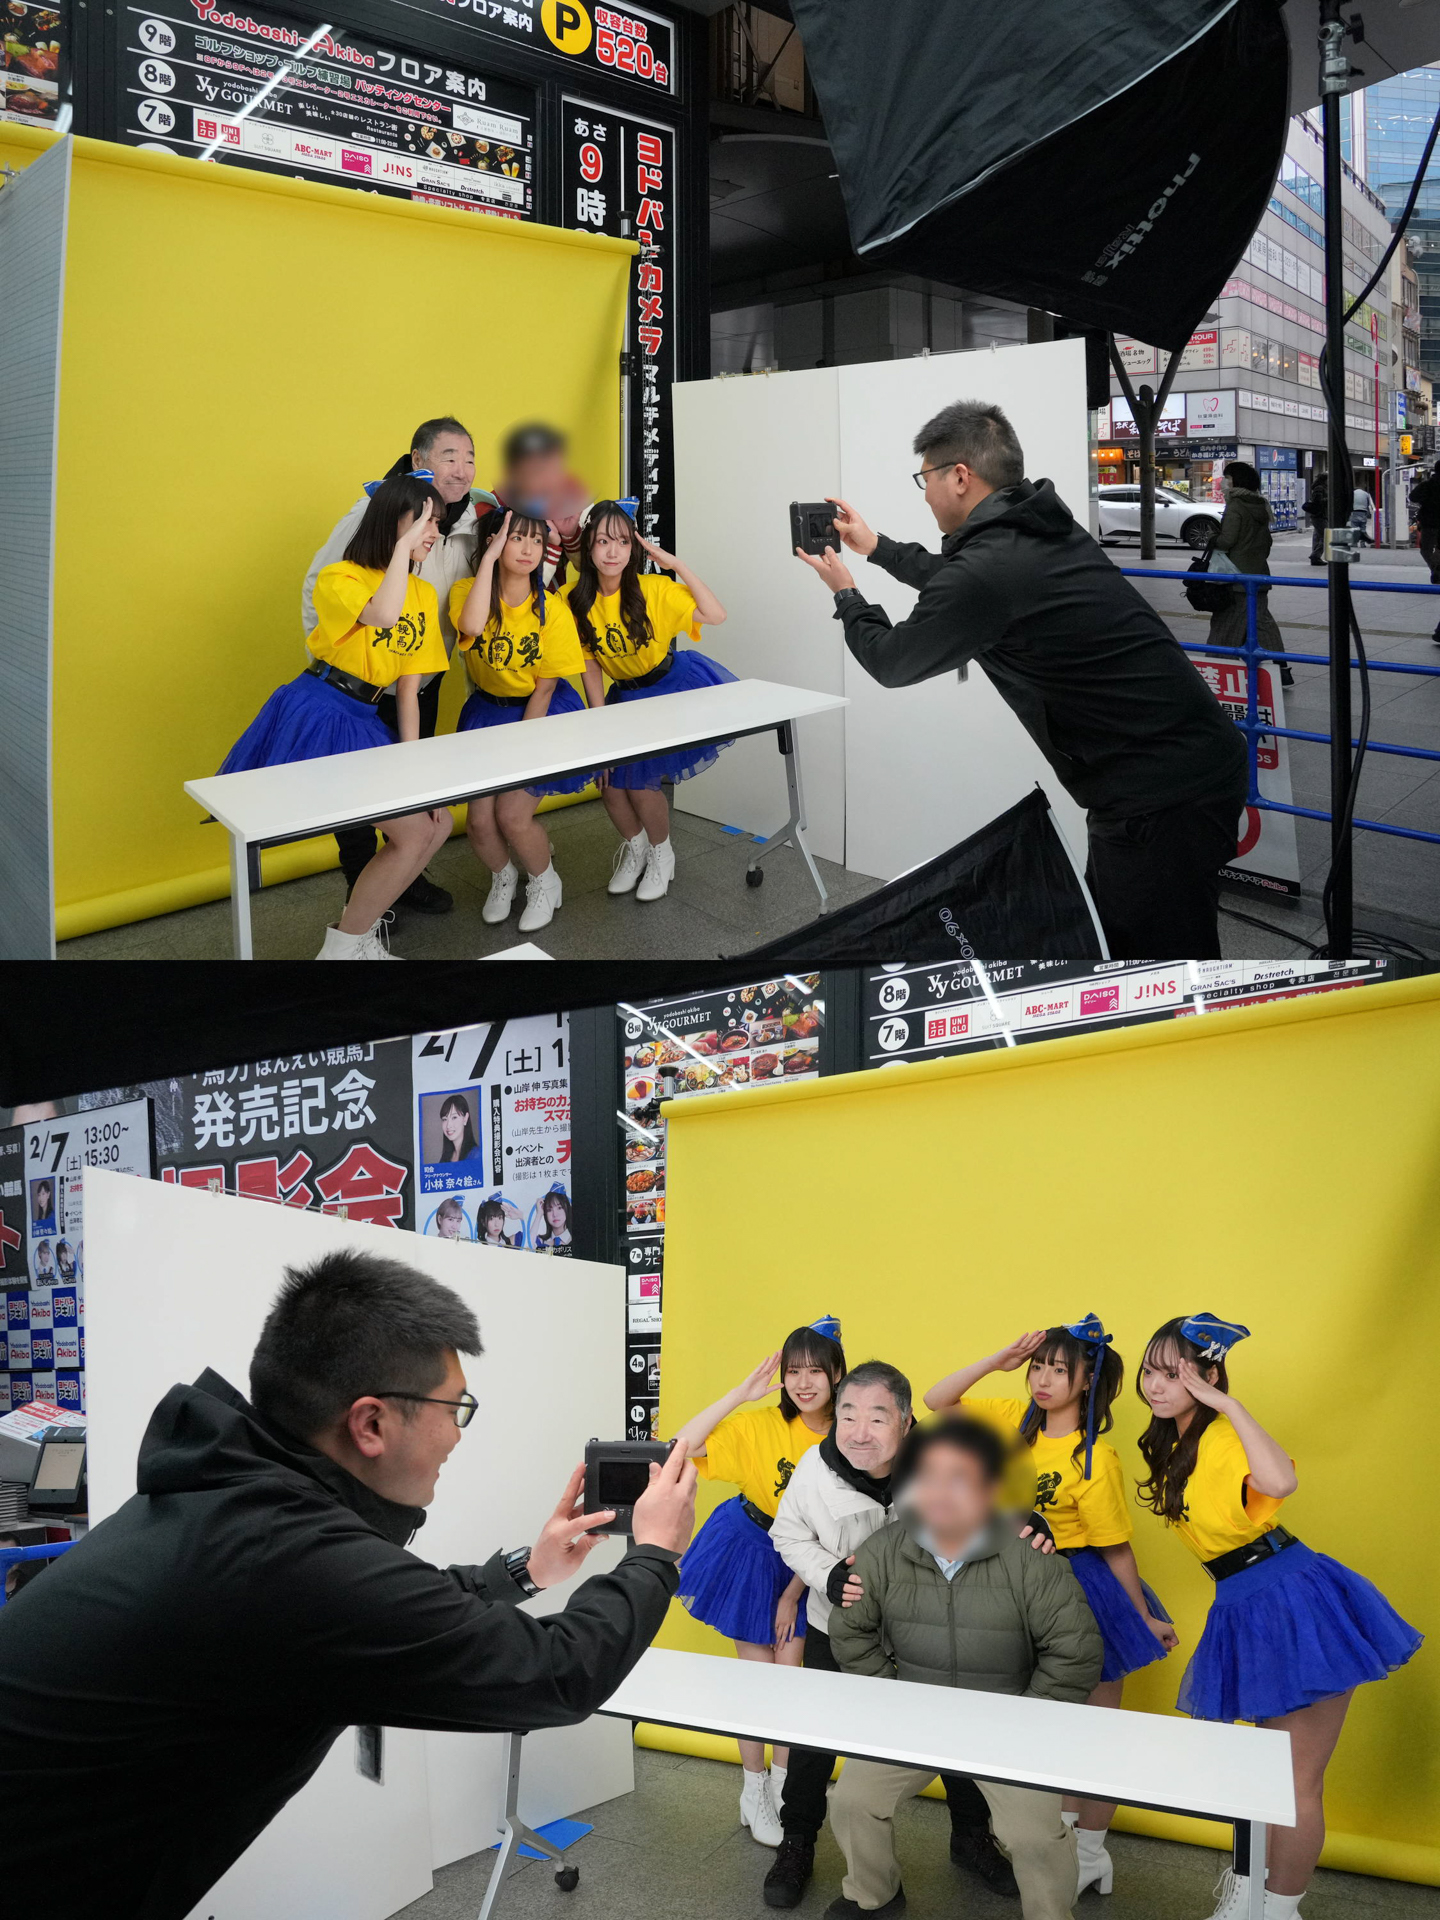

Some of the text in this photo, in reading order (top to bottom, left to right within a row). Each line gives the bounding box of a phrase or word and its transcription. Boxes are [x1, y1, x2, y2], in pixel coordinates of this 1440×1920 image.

[555, 4, 581, 41] P
[595, 6, 648, 41] 収容台数
[145, 24, 172, 48] 9階
[144, 63, 172, 87] 8階
[376, 50, 486, 101] フロア案内
[355, 79, 451, 113] バッティングセンター
[144, 104, 172, 127] 7階
[367, 126, 398, 138] Restaurants
[574, 117, 607, 142] あさ
[295, 143, 333, 158] ABC-MART
[344, 153, 369, 163] DAISO
[579, 142, 603, 183] 9
[576, 187, 607, 226] 時
[882, 985, 907, 1003] 8階
[1084, 989, 1116, 1000] DAISO
[1193, 982, 1275, 1000] pecialty shop
[1025, 1001, 1070, 1016] ABC-MART
[661, 1011, 712, 1030] GOURMET
[882, 1024, 907, 1042] 7階
[542, 1078, 568, 1091] 写真集
[192, 1068, 377, 1151] 発売記念
[30, 1130, 70, 1173] 2/7
[84, 1144, 120, 1167] 15:30
[515, 1142, 543, 1155] イベント
[515, 1155, 554, 1169] 出演者との
[425, 1176, 482, 1190] 小林 奈々絵さん
[31, 1308, 51, 1318] Akiba
[10, 1349, 30, 1359] Akiba
[56, 1347, 77, 1358] Akiba
[35, 1389, 55, 1400] Akiba
